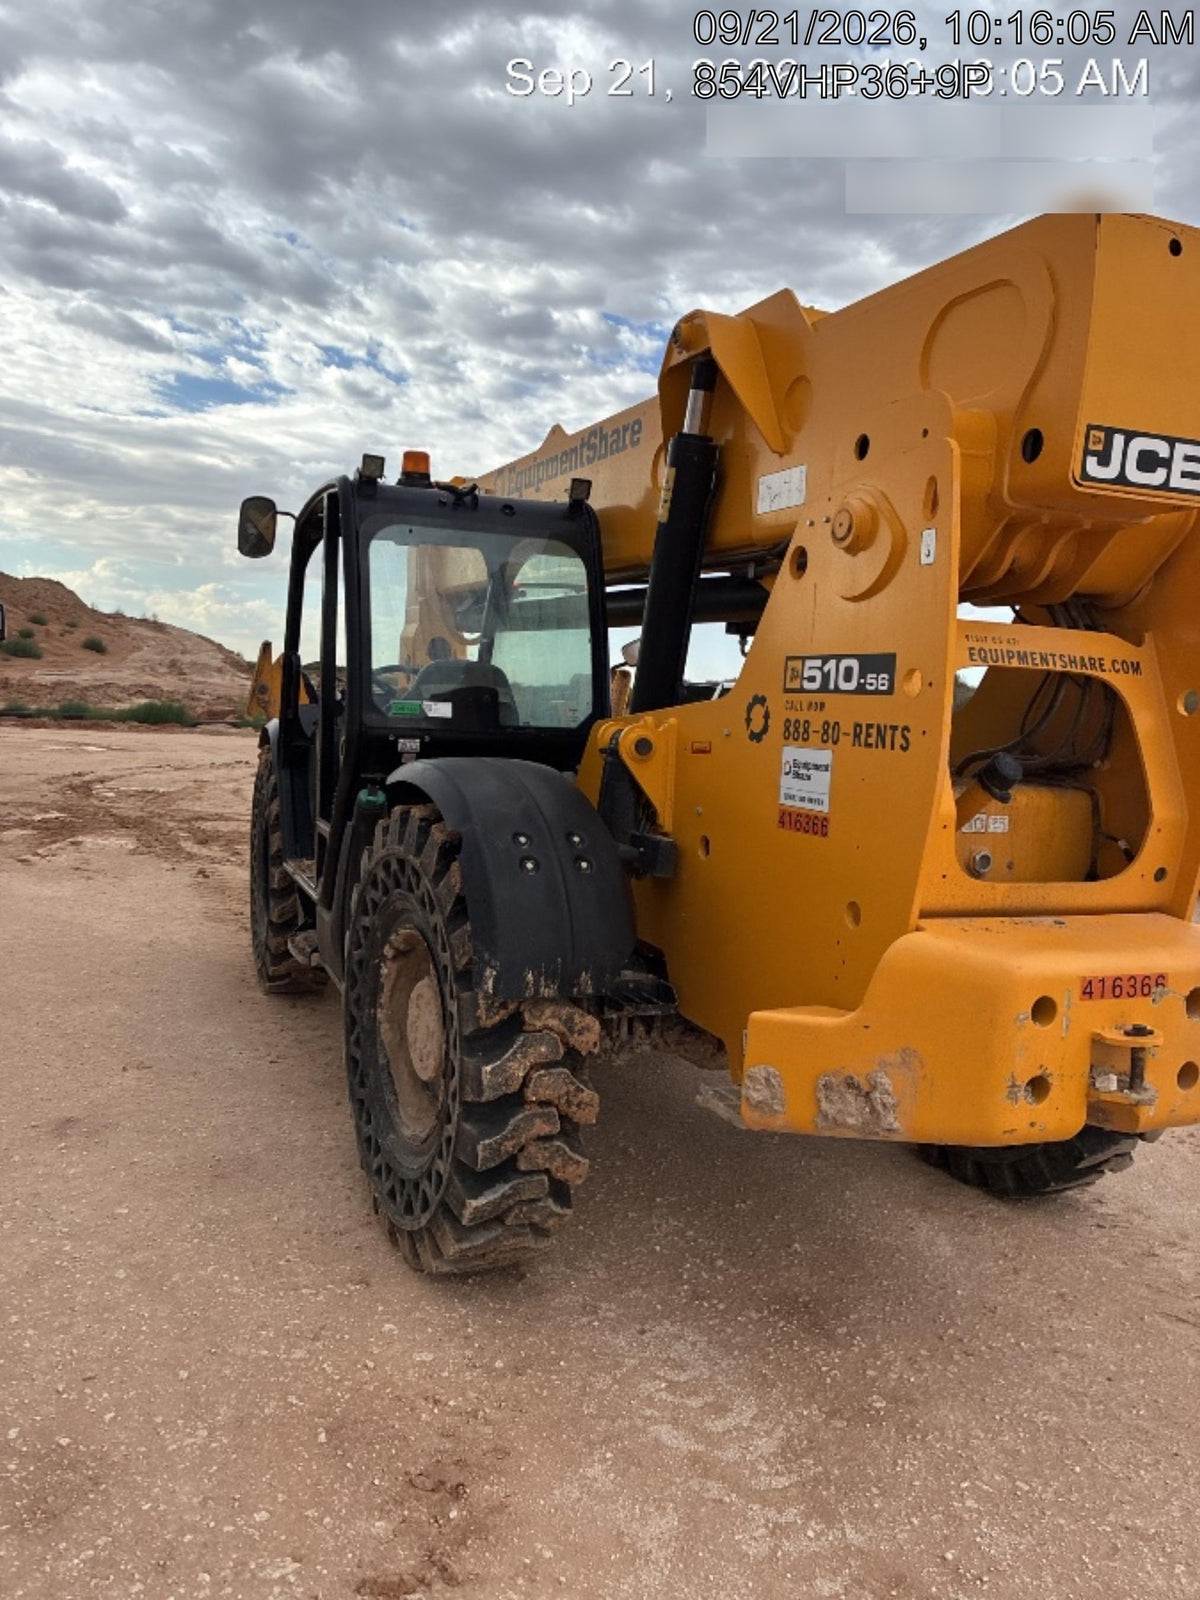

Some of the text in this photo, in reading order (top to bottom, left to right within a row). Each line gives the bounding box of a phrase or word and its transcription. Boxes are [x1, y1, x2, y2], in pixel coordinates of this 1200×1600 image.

[507, 417, 643, 498] EquipmentShare
[968, 646, 1143, 676] EQUIPMENTSHARE.COM
[783, 718, 912, 752] 888-80-RENTS
[777, 811, 829, 838] 416366
